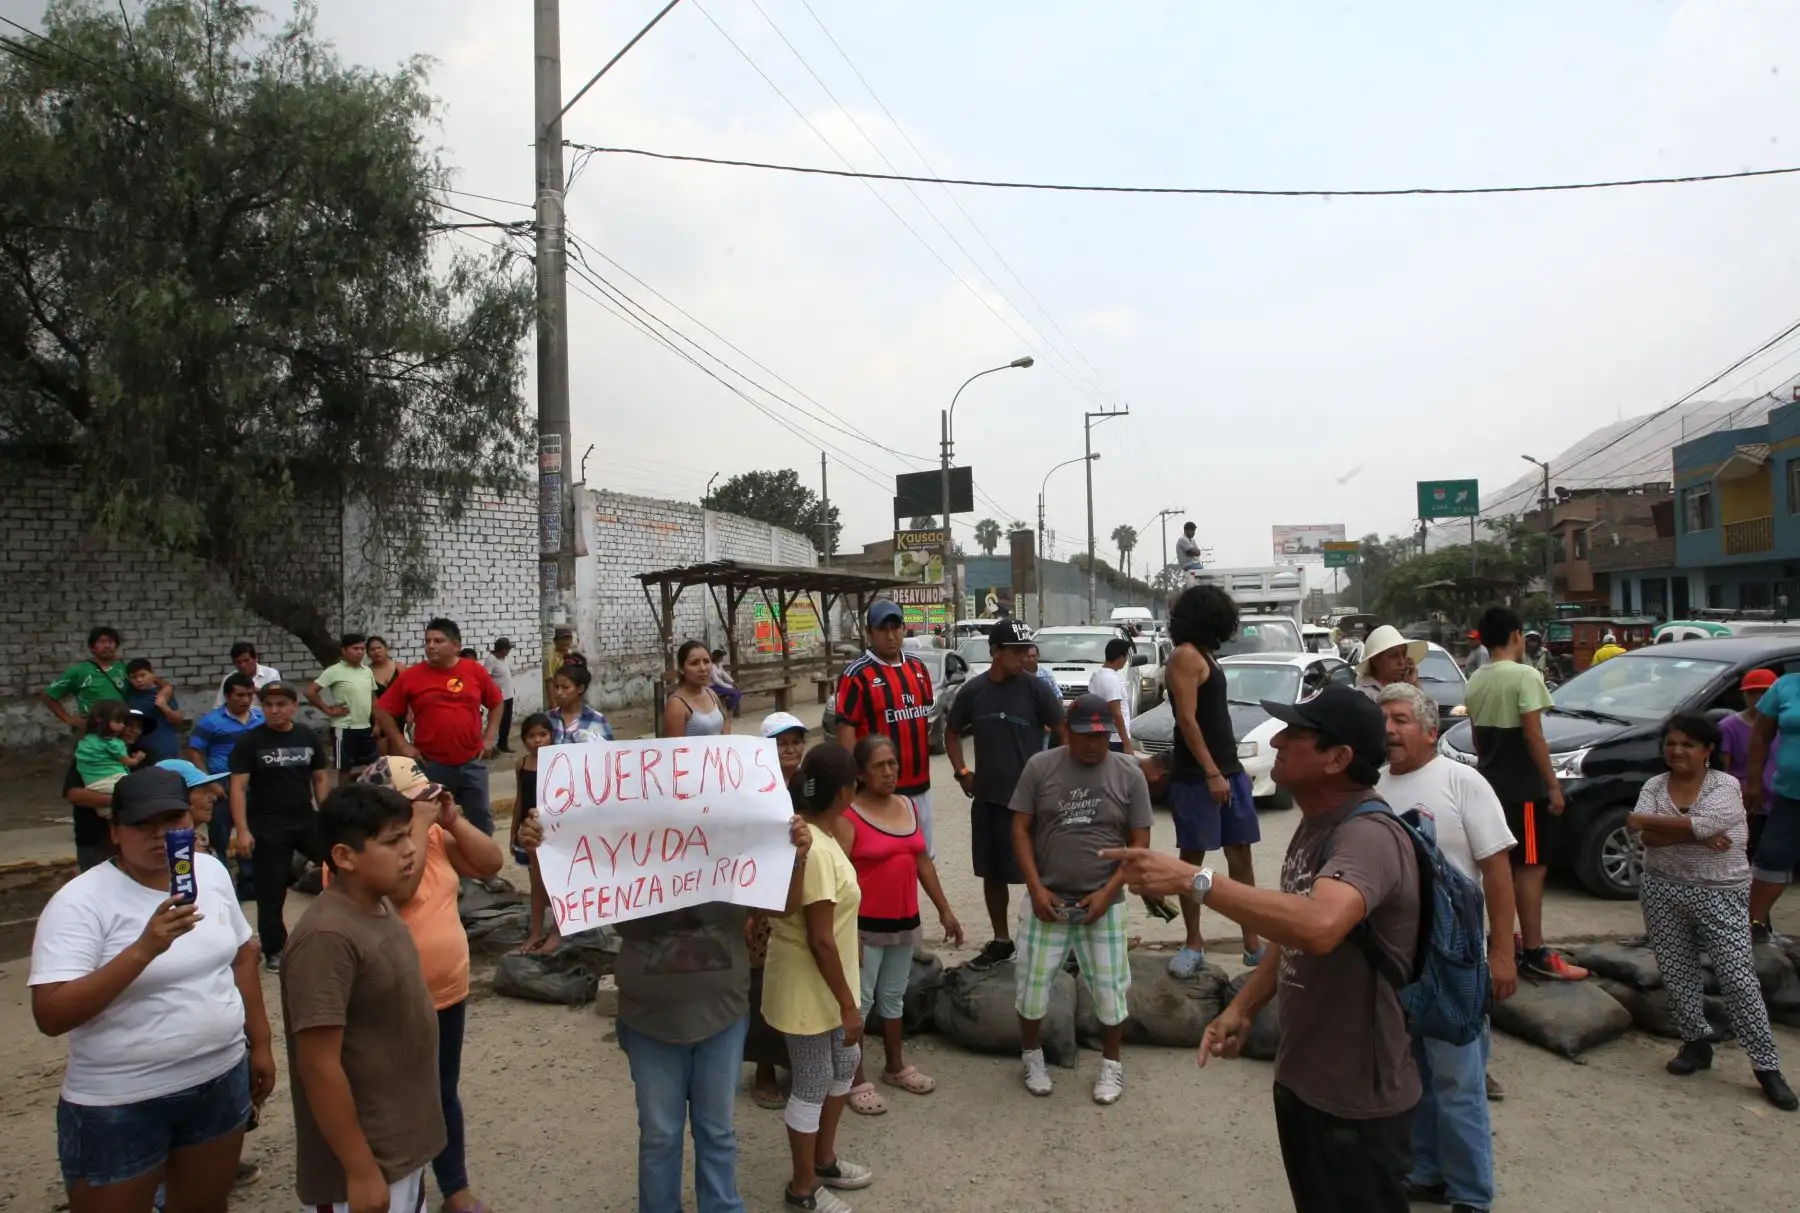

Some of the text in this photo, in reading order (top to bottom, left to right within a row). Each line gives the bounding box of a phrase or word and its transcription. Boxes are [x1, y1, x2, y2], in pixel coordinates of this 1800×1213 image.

[901, 693, 915, 705] Fly
[543, 746, 778, 816] QUEREMOS
[174, 845, 193, 893] VOLT
[550, 873, 664, 928] DEFENZA
